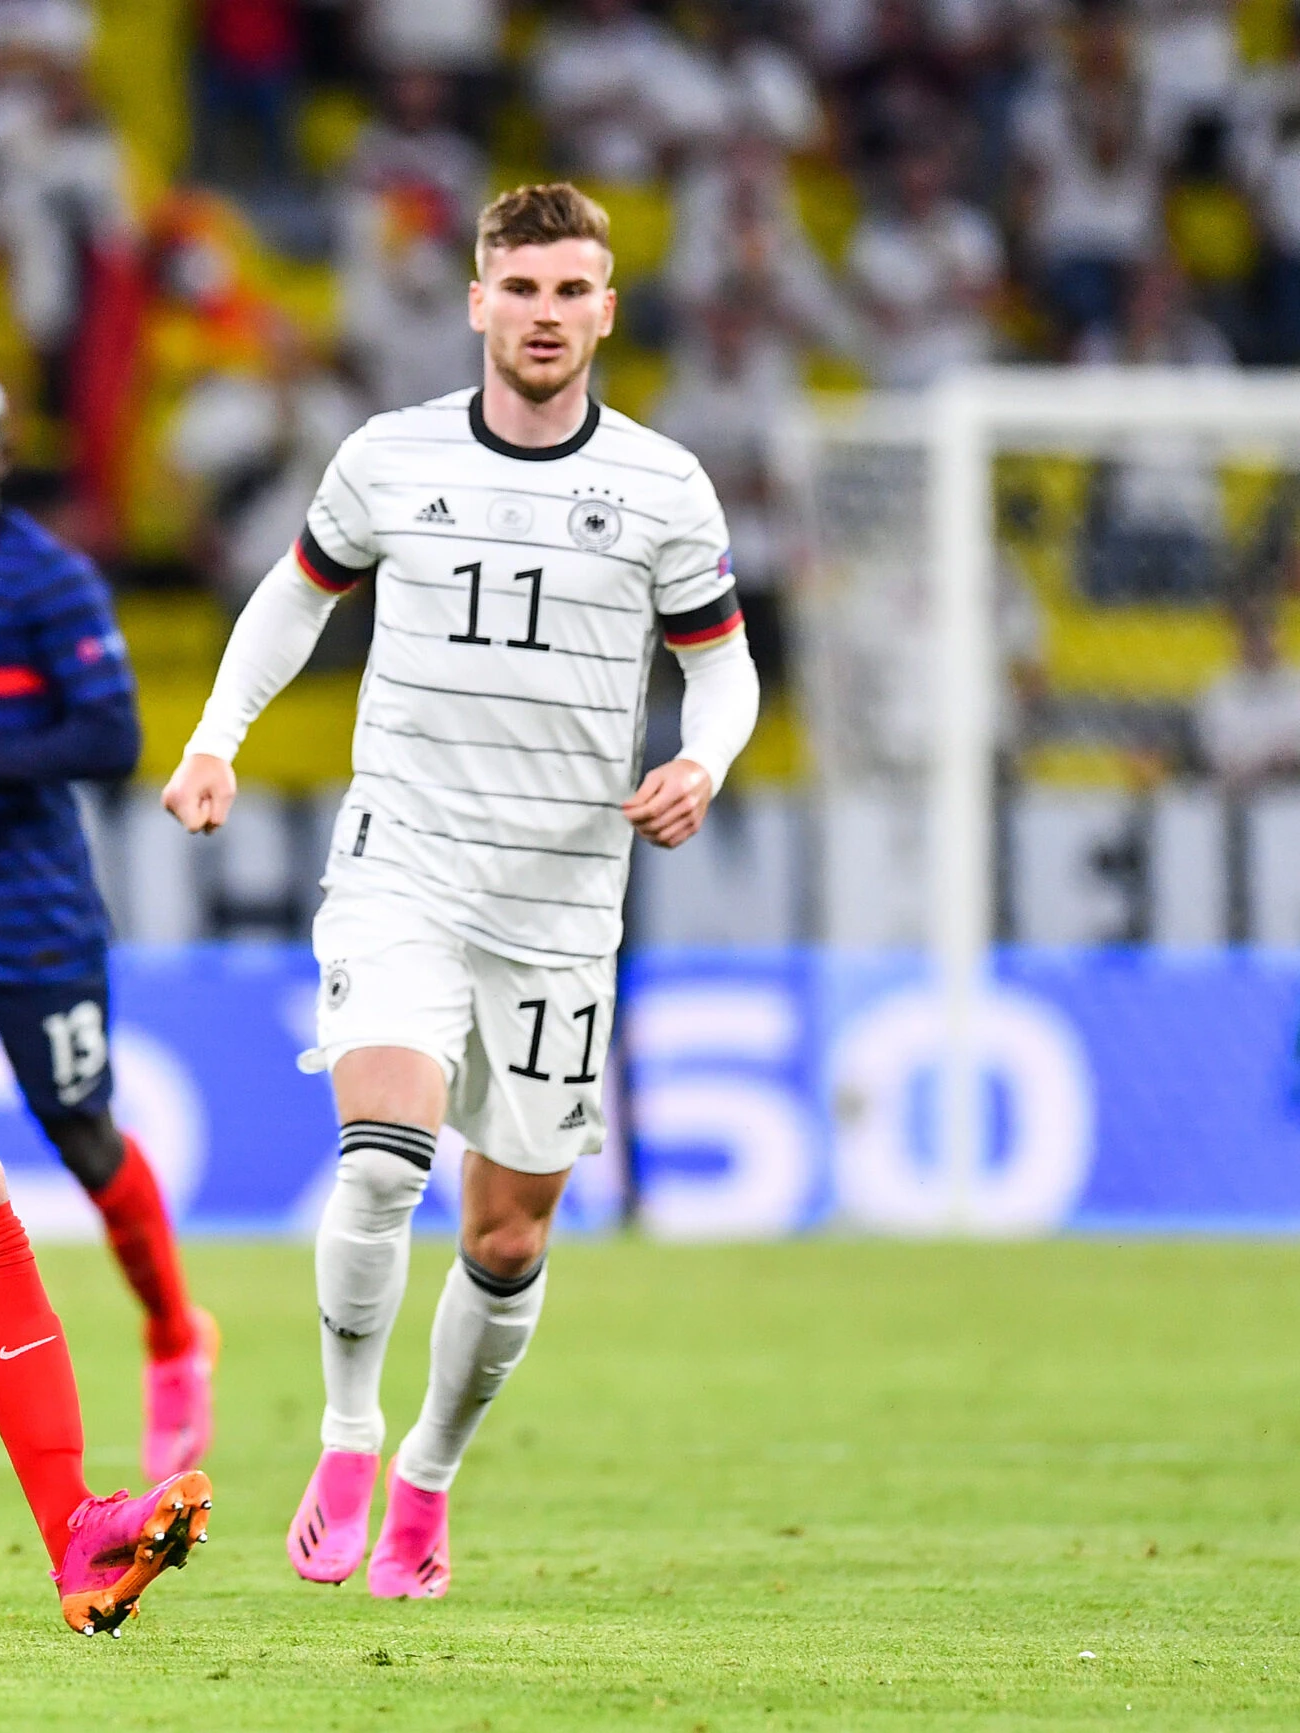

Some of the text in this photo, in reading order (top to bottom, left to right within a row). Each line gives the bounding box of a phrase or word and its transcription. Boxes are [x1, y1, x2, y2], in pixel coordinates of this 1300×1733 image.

[448, 561, 550, 651] 11
[43, 1001, 107, 1086] 13
[508, 999, 598, 1084] 11
